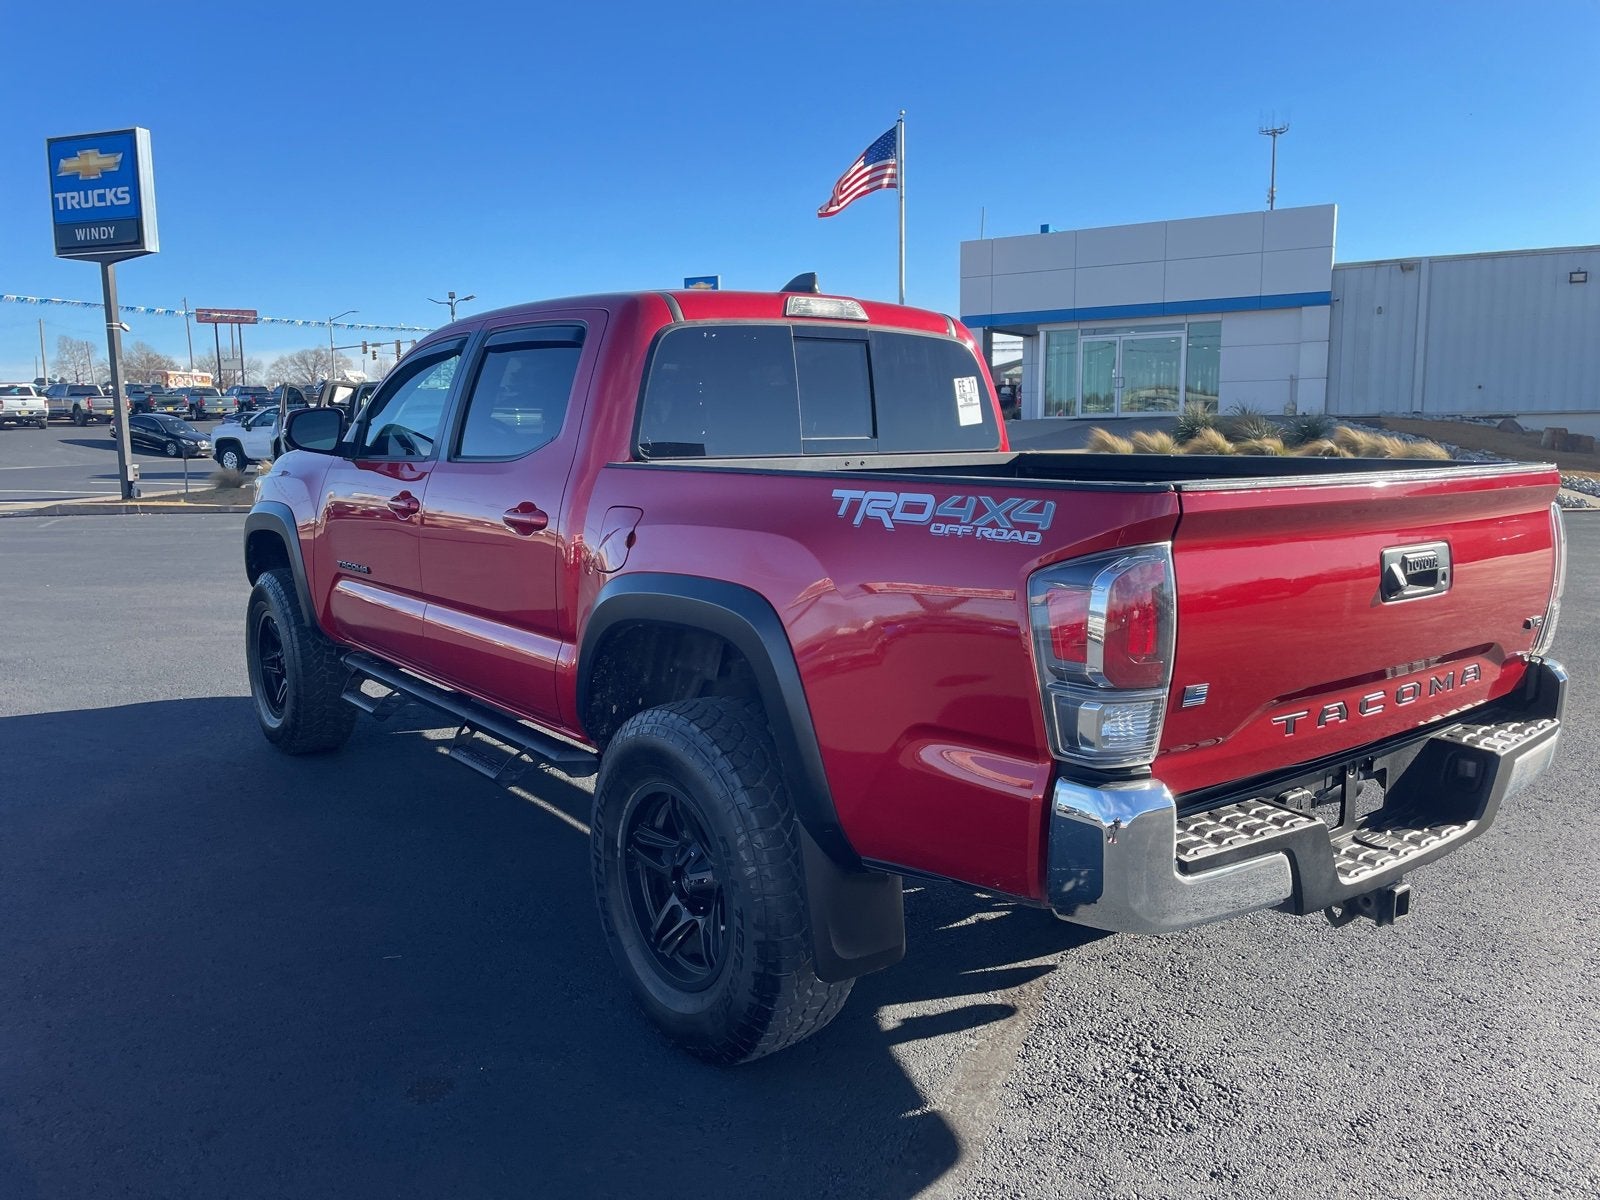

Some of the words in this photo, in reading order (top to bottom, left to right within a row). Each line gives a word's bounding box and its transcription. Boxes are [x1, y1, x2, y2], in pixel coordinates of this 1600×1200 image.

[55, 186, 130, 210] TRUCKS
[75, 226, 115, 241] WINDY
[831, 489, 936, 532] TRD
[935, 495, 1057, 531] 4X4
[929, 523, 975, 538] OFF
[975, 526, 1043, 546] ROAD
[1407, 555, 1438, 572] TOYOTA
[1272, 663, 1482, 737] TACOMA
